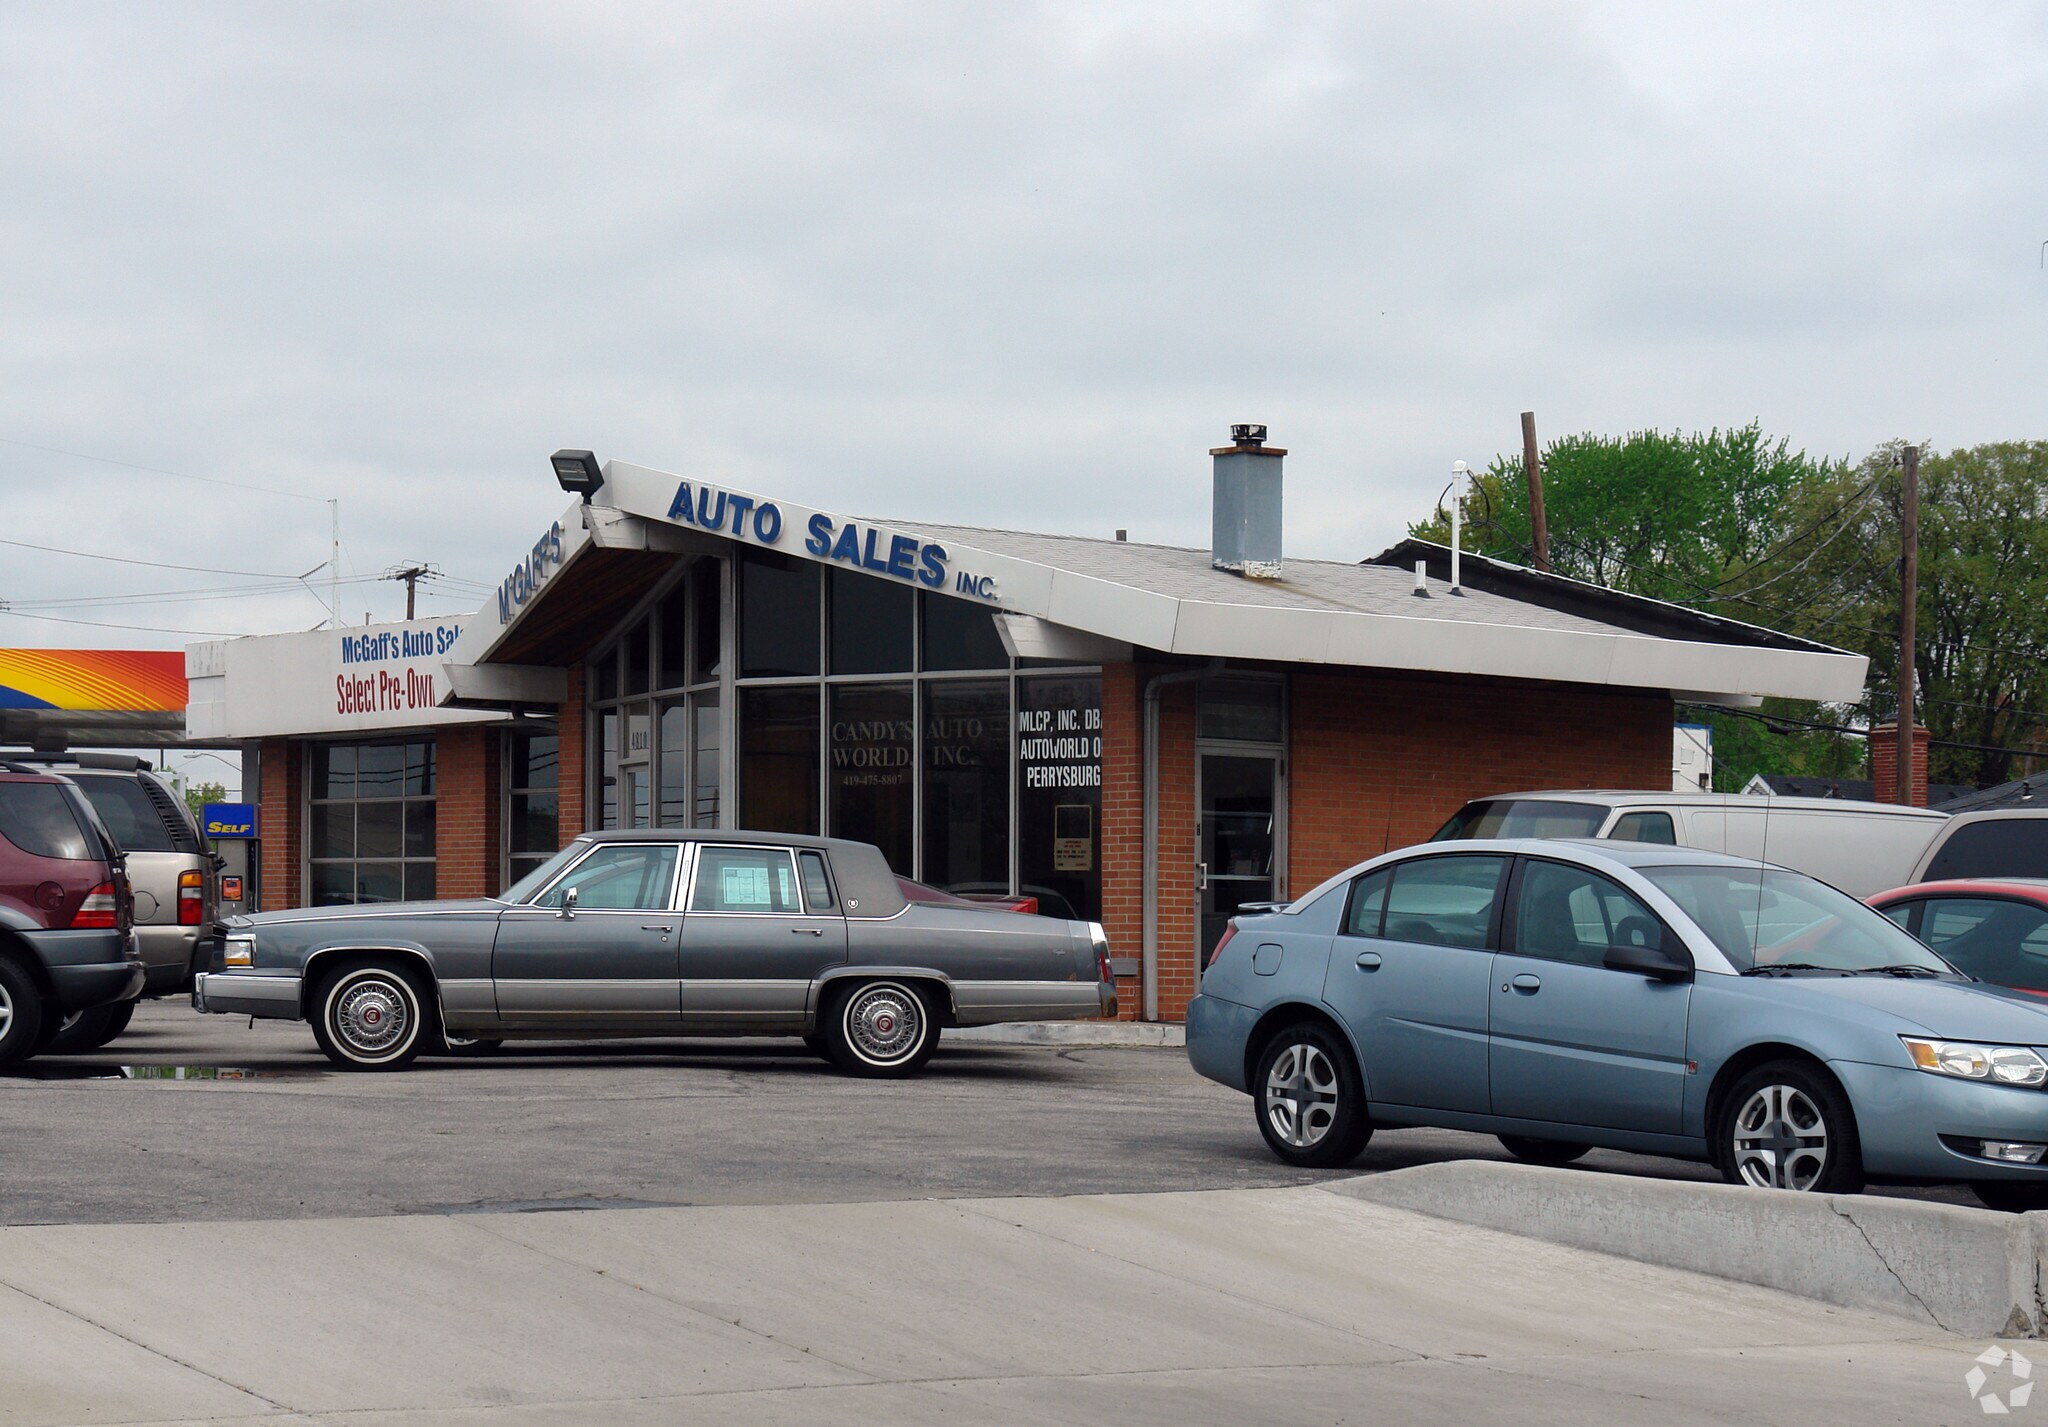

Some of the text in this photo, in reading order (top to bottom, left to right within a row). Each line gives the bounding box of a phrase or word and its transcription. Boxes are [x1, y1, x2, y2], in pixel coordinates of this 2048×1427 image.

[667, 482, 999, 600] AUTO SALES INC.
[342, 624, 464, 664] McGaff's Auto Sal
[337, 673, 376, 714] Select
[832, 718, 982, 742] CANDY'S AUTO
[1019, 708, 1103, 732] MLCP, INC. DB
[933, 746, 976, 766] INC.
[1020, 736, 1103, 760] AUTOWORLD O
[1027, 765, 1101, 787] PERRYSBURG
[207, 821, 250, 833] SELF
